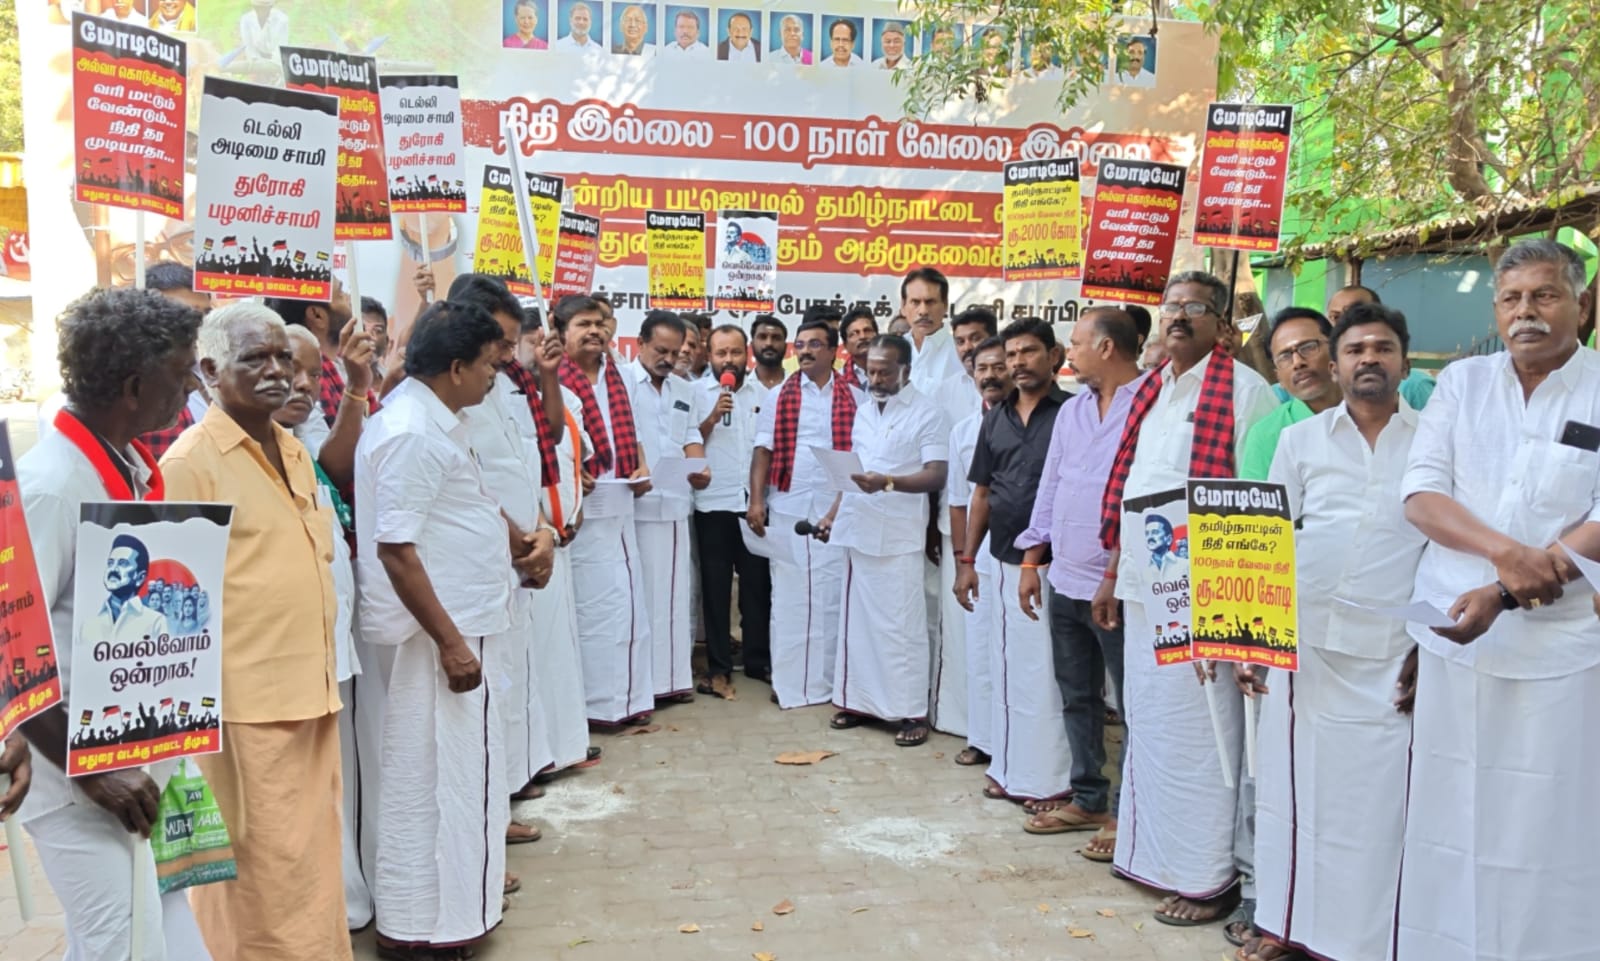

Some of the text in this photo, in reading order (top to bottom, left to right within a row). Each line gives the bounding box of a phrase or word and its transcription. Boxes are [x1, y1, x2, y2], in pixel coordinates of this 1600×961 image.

[80, 21, 180, 66] மோடியே!
[77, 57, 116, 77] அல்வா
[289, 53, 370, 84] மோடியே!
[94, 82, 176, 111] வரி மட்டும்
[399, 95, 437, 109] டெல்லி
[383, 111, 454, 127] அடிமை சாமி
[1213, 108, 1286, 128] மோடியே!
[109, 120, 164, 142] நிதி தர
[243, 118, 302, 141] டெல்லி
[499, 102, 559, 149] நிதி
[567, 104, 714, 148] இல்லை
[743, 121, 800, 152] 100
[807, 120, 890, 163] நாள்
[896, 121, 1013, 162] வேலை
[211, 137, 326, 166] அடிமை சாமி
[398, 132, 444, 151] துரோகி
[1216, 154, 1238, 163] வரி
[1008, 161, 1074, 180] மோடியே!
[1103, 163, 1181, 188] மோடியே!
[234, 172, 306, 198] துரோகி
[1222, 181, 1242, 193] நிதி
[208, 202, 320, 229] பழனிச்சாமி
[815, 190, 984, 227] தமிழ்நாட்டை
[1106, 208, 1129, 218] வரி
[1131, 211, 1169, 223] மட்டும்
[649, 213, 701, 229] மோடியே!
[1112, 235, 1156, 250] நிதி தர
[1193, 485, 1284, 512] மோடியே!
[1199, 521, 1283, 538] தமிழ்நாட்டின்
[1202, 537, 1277, 554] நிதி எங்கே?
[1237, 558, 1271, 571] வேலை
[1196, 575, 1255, 607] ரூ.2000
[1257, 576, 1292, 615] கோடி
[93, 628, 211, 662] வெல்வோம்
[110, 657, 197, 692] ஒன்றாக!
